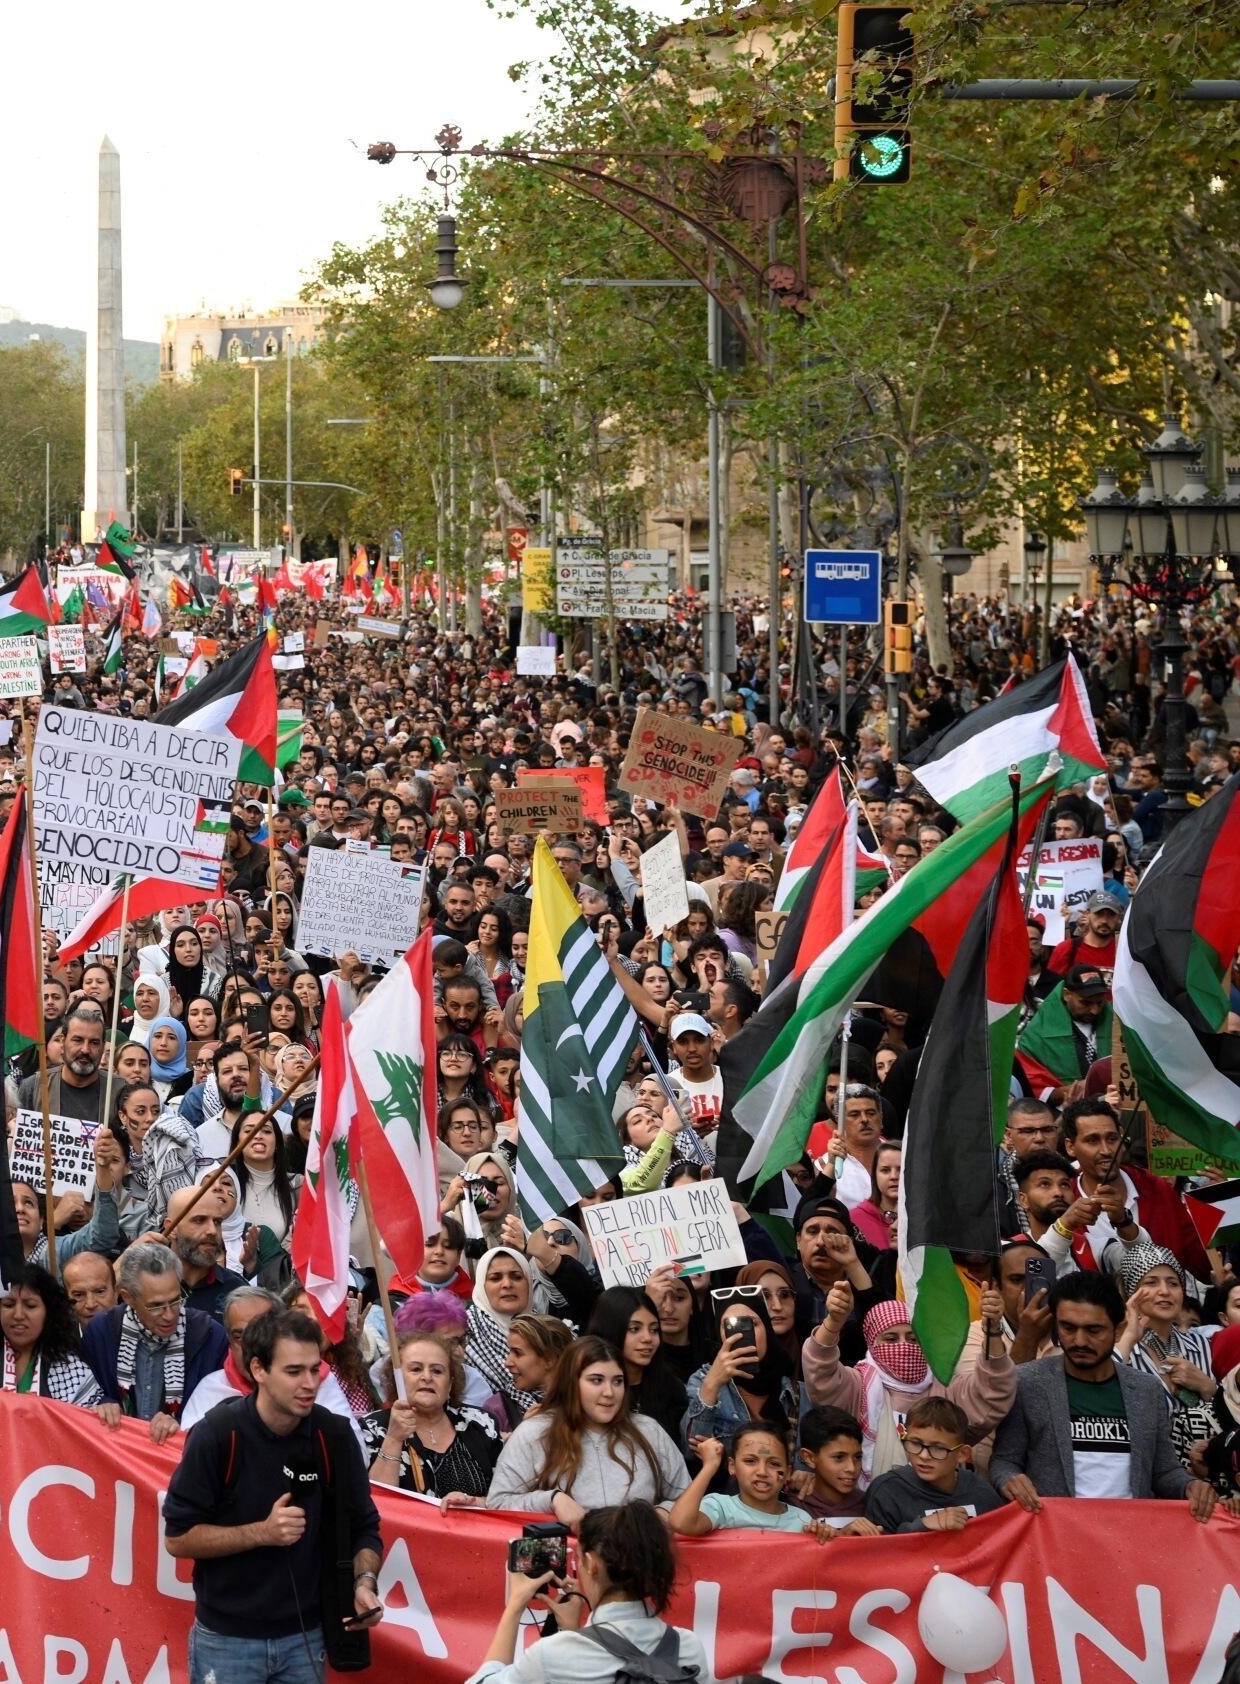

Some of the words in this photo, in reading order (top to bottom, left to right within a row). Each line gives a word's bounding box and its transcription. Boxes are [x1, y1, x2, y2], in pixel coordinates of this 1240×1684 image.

[586, 569, 624, 579] Lesps
[0, 650, 20, 658] WRONG
[20, 658, 39, 667] AFRICA
[1, 671, 22, 679] WRONG
[44, 710, 108, 749] QUIÉN
[110, 723, 140, 752] IBA
[144, 731, 156, 756] A
[167, 733, 229, 768] DECIR
[654, 736, 687, 756] STOP
[692, 750, 716, 767] THIS
[39, 745, 79, 773] QUE
[81, 753, 113, 777] LOS
[120, 760, 236, 800] DESCENDIENTES
[34, 770, 70, 800] DEL
[86, 777, 196, 820] HOLOCAUSTO
[499, 790, 559, 804] PROTECT
[562, 794, 579, 803] THE
[33, 800, 147, 837] PROVOCARÍAN
[166, 819, 194, 846] UN
[500, 805, 558, 818] CHILDREN
[33, 826, 181, 874] GENOCIDIO
[1058, 843, 1100, 862] ASESINA
[47, 860, 79, 884] MAY
[311, 849, 323, 861] SI
[326, 852, 344, 866] HAY
[344, 855, 363, 870] QUE
[365, 860, 400, 876] HACER
[310, 861, 339, 879] MILES
[341, 868, 358, 881] DE
[360, 871, 412, 893] PROTESTAS
[40, 883, 56, 906] IN
[305, 885, 324, 898] QUE
[325, 889, 376, 907] BOMBARDEAR
[307, 875, 331, 888] PARA
[333, 881, 377, 900] MOSTRAR
[379, 888, 391, 903] AL
[393, 892, 420, 907] MUNDO
[1036, 894, 1055, 909] UN
[303, 896, 315, 909] NO
[360, 906, 374, 918] ES
[375, 909, 409, 924] CUANDO
[301, 920, 336, 932] FALLADO
[339, 924, 361, 936] COMO
[365, 928, 415, 944] HUMANIDAD
[303, 909, 314, 919] TE
[315, 910, 331, 921] DAS
[333, 913, 364, 926] CUENTA
[368, 919, 387, 931] QUE
[389, 923, 416, 936] HEMOS
[344, 940, 392, 957] PALESTINE
[18, 1113, 70, 1132] ISREL
[17, 1127, 90, 1149] BOMARDEA
[13, 1151, 76, 1169] PRETXTO
[80, 1161, 94, 1172] DE
[59, 1147, 80, 1158] CON
[82, 1150, 95, 1162] EL
[12, 1161, 87, 1187] BOMBRDEAR
[585, 1206, 629, 1237] DEL
[660, 1194, 685, 1222] AL
[687, 1184, 728, 1217] MAR
[594, 1226, 686, 1270] PALESTINA
[687, 1216, 731, 1253] SERÁ
[299, 1473, 318, 1481] acn
[378, 1537, 448, 1659] A
[506, 1540, 1240, 1684] LESIN
